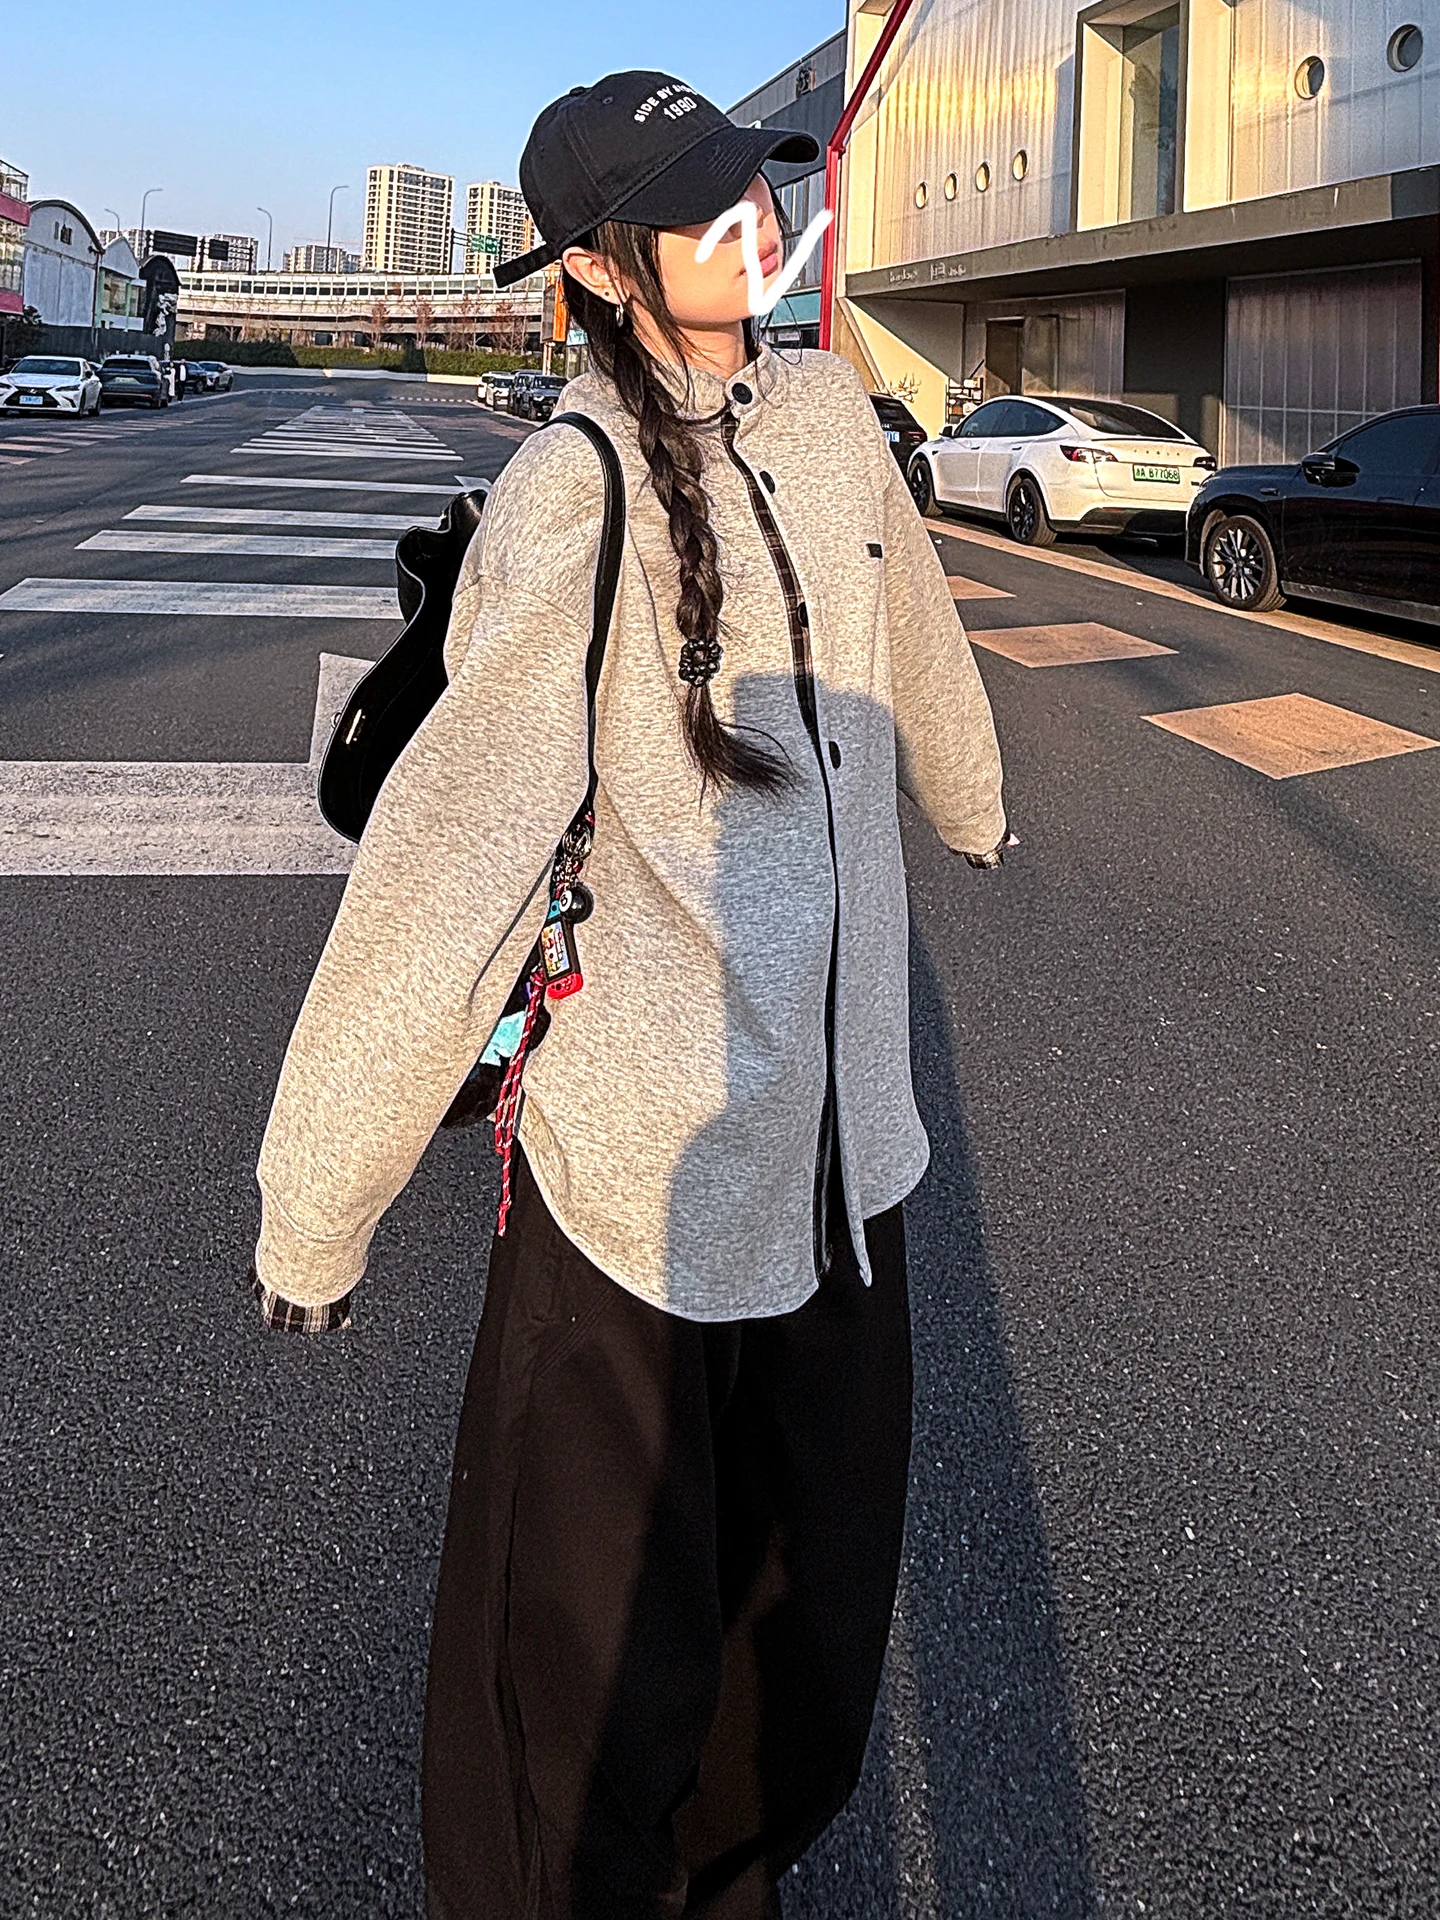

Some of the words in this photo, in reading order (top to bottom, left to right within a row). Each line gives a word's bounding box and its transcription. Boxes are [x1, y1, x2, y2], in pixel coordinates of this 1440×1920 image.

[634, 97, 659, 122] SIDE
[656, 86, 673, 99] BY
[663, 97, 697, 119] 1990
